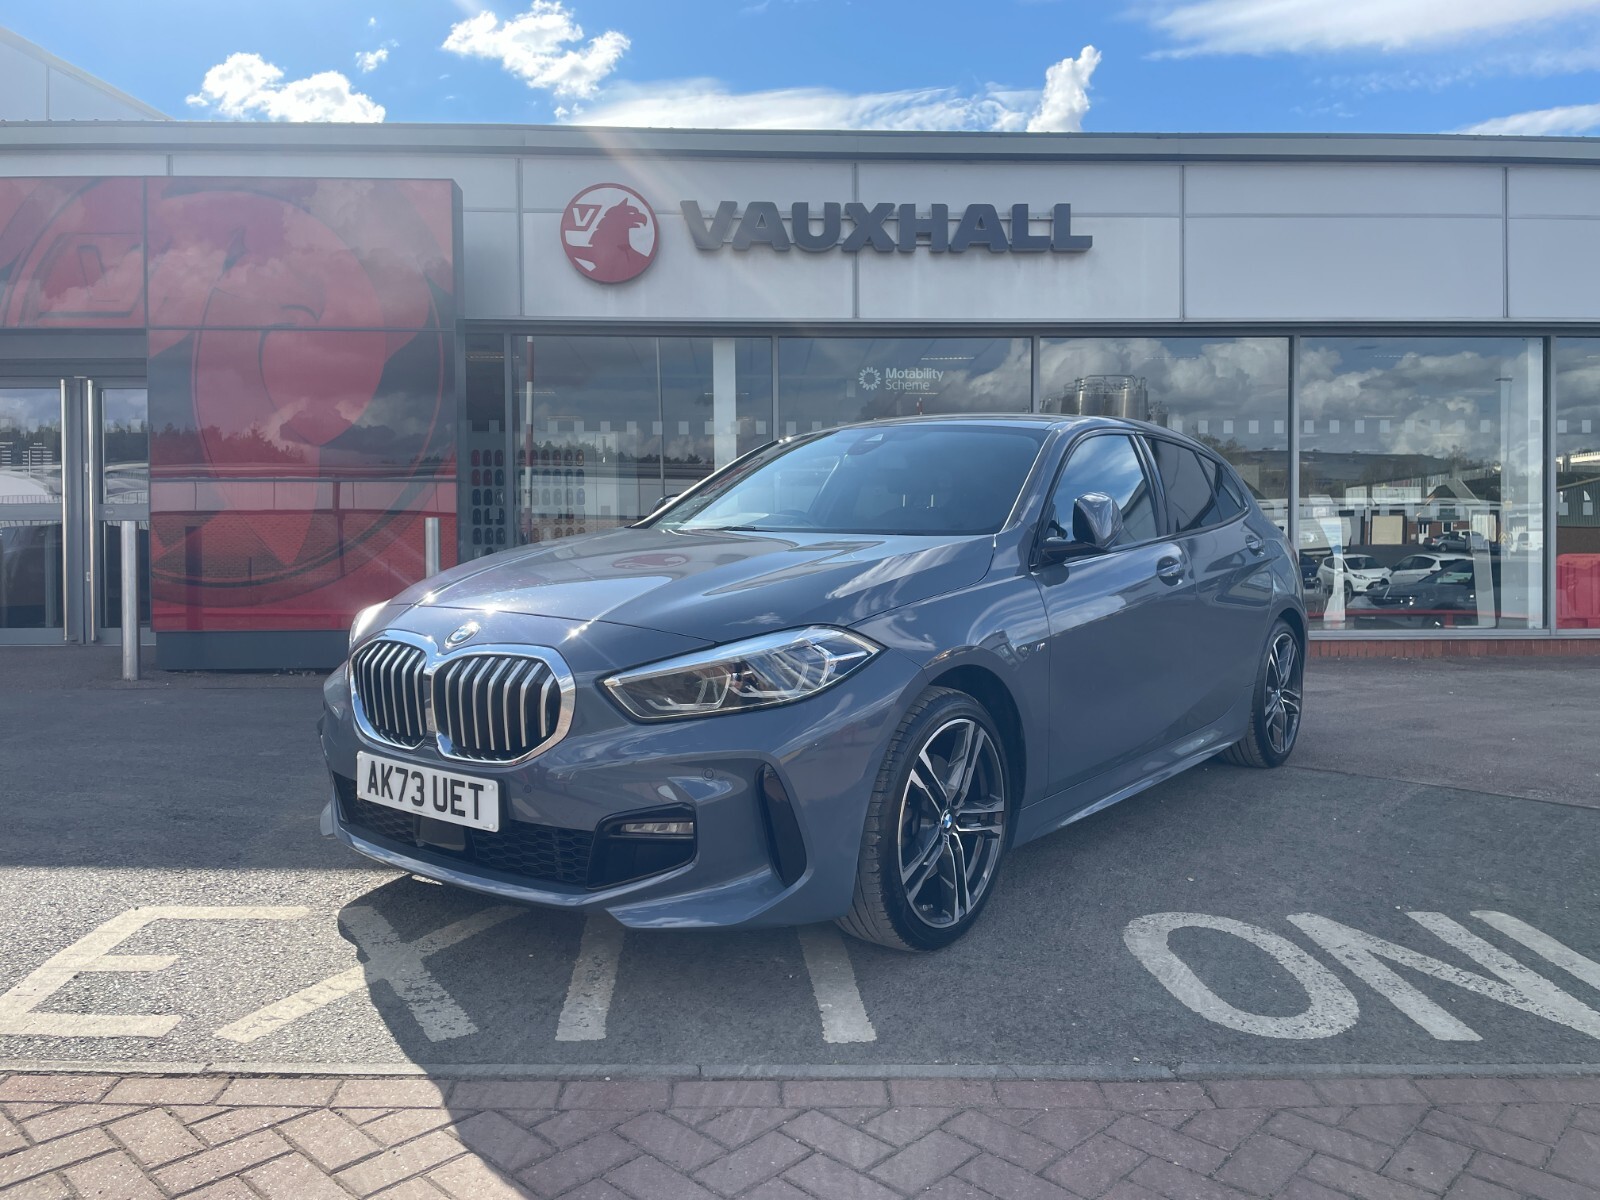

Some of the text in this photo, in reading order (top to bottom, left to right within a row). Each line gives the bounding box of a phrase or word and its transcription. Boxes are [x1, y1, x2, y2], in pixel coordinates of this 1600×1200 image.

[680, 200, 1093, 253] VAUXHALL
[885, 367, 944, 381] Motability
[885, 379, 930, 390] Scheme
[367, 760, 485, 820] AK73 UET
